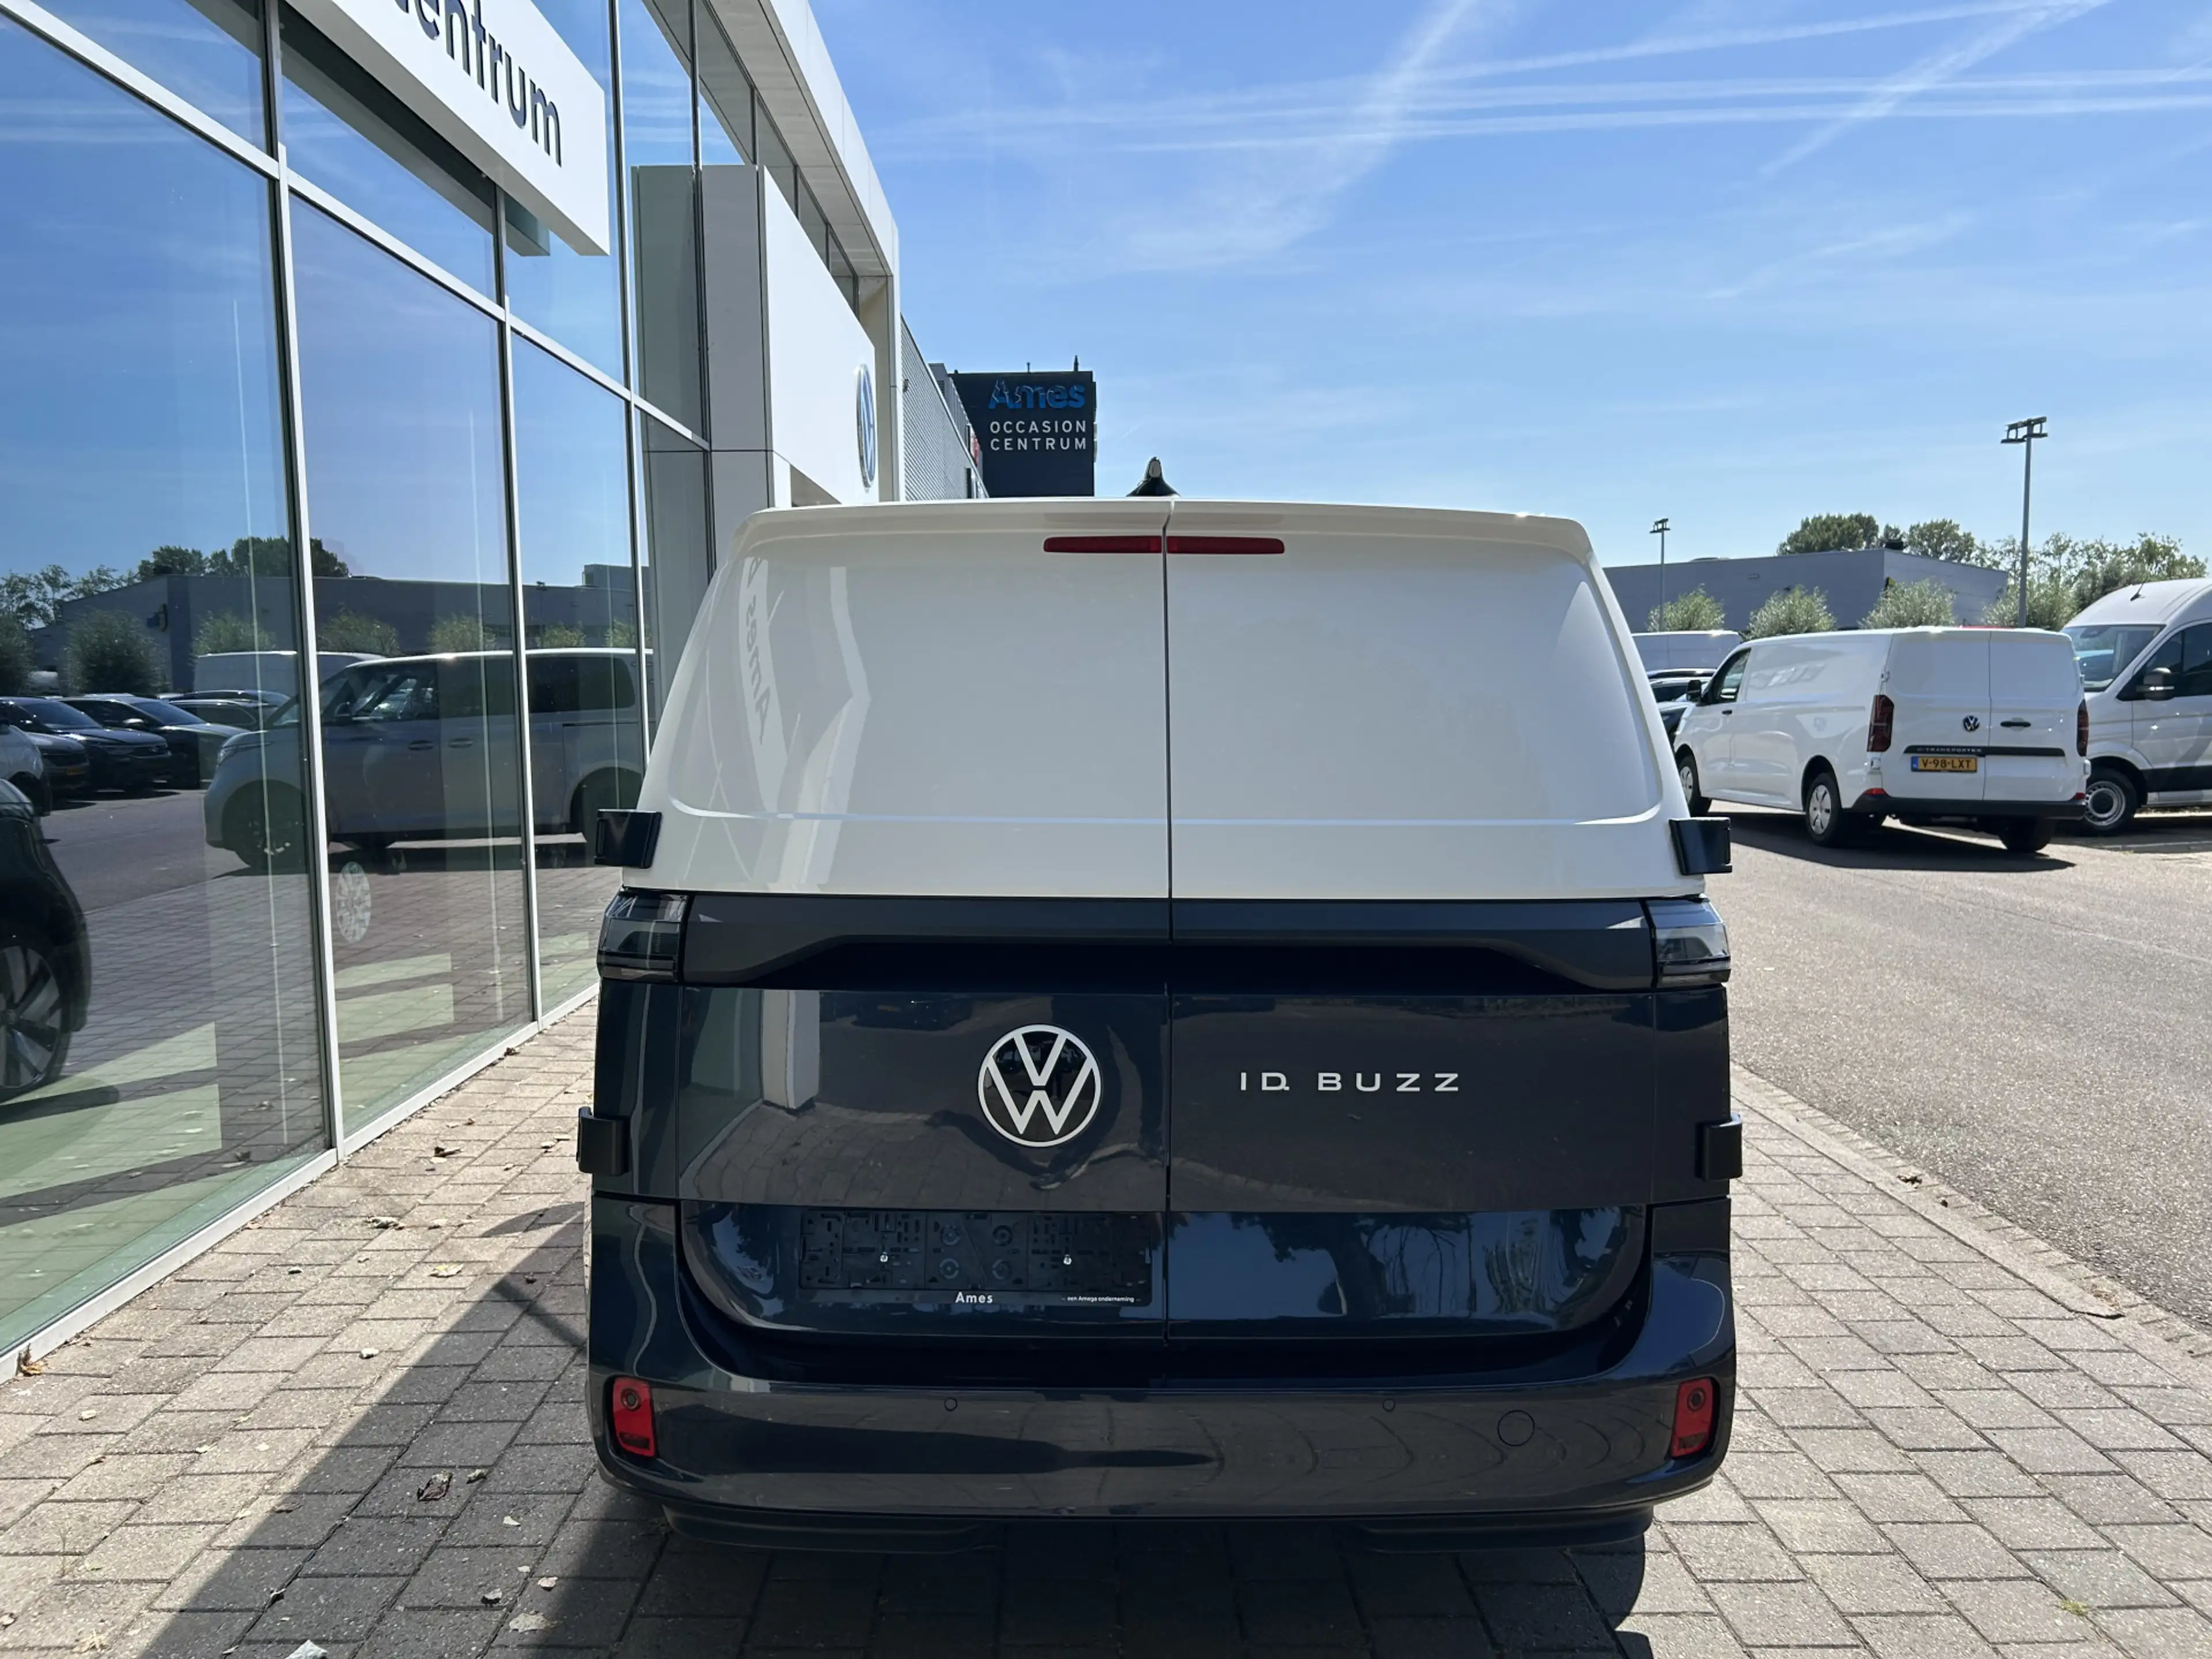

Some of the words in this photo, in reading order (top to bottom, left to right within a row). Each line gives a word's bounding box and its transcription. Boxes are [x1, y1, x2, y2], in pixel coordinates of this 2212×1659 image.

[988, 378, 1086, 410] Ames
[990, 421, 1086, 433] OCCASION
[990, 438, 1086, 450] CENTRUM
[1922, 759, 1971, 769] V-98-LXT
[1317, 1072, 1459, 1092] BUZZ
[955, 1292, 993, 1304] Ames
